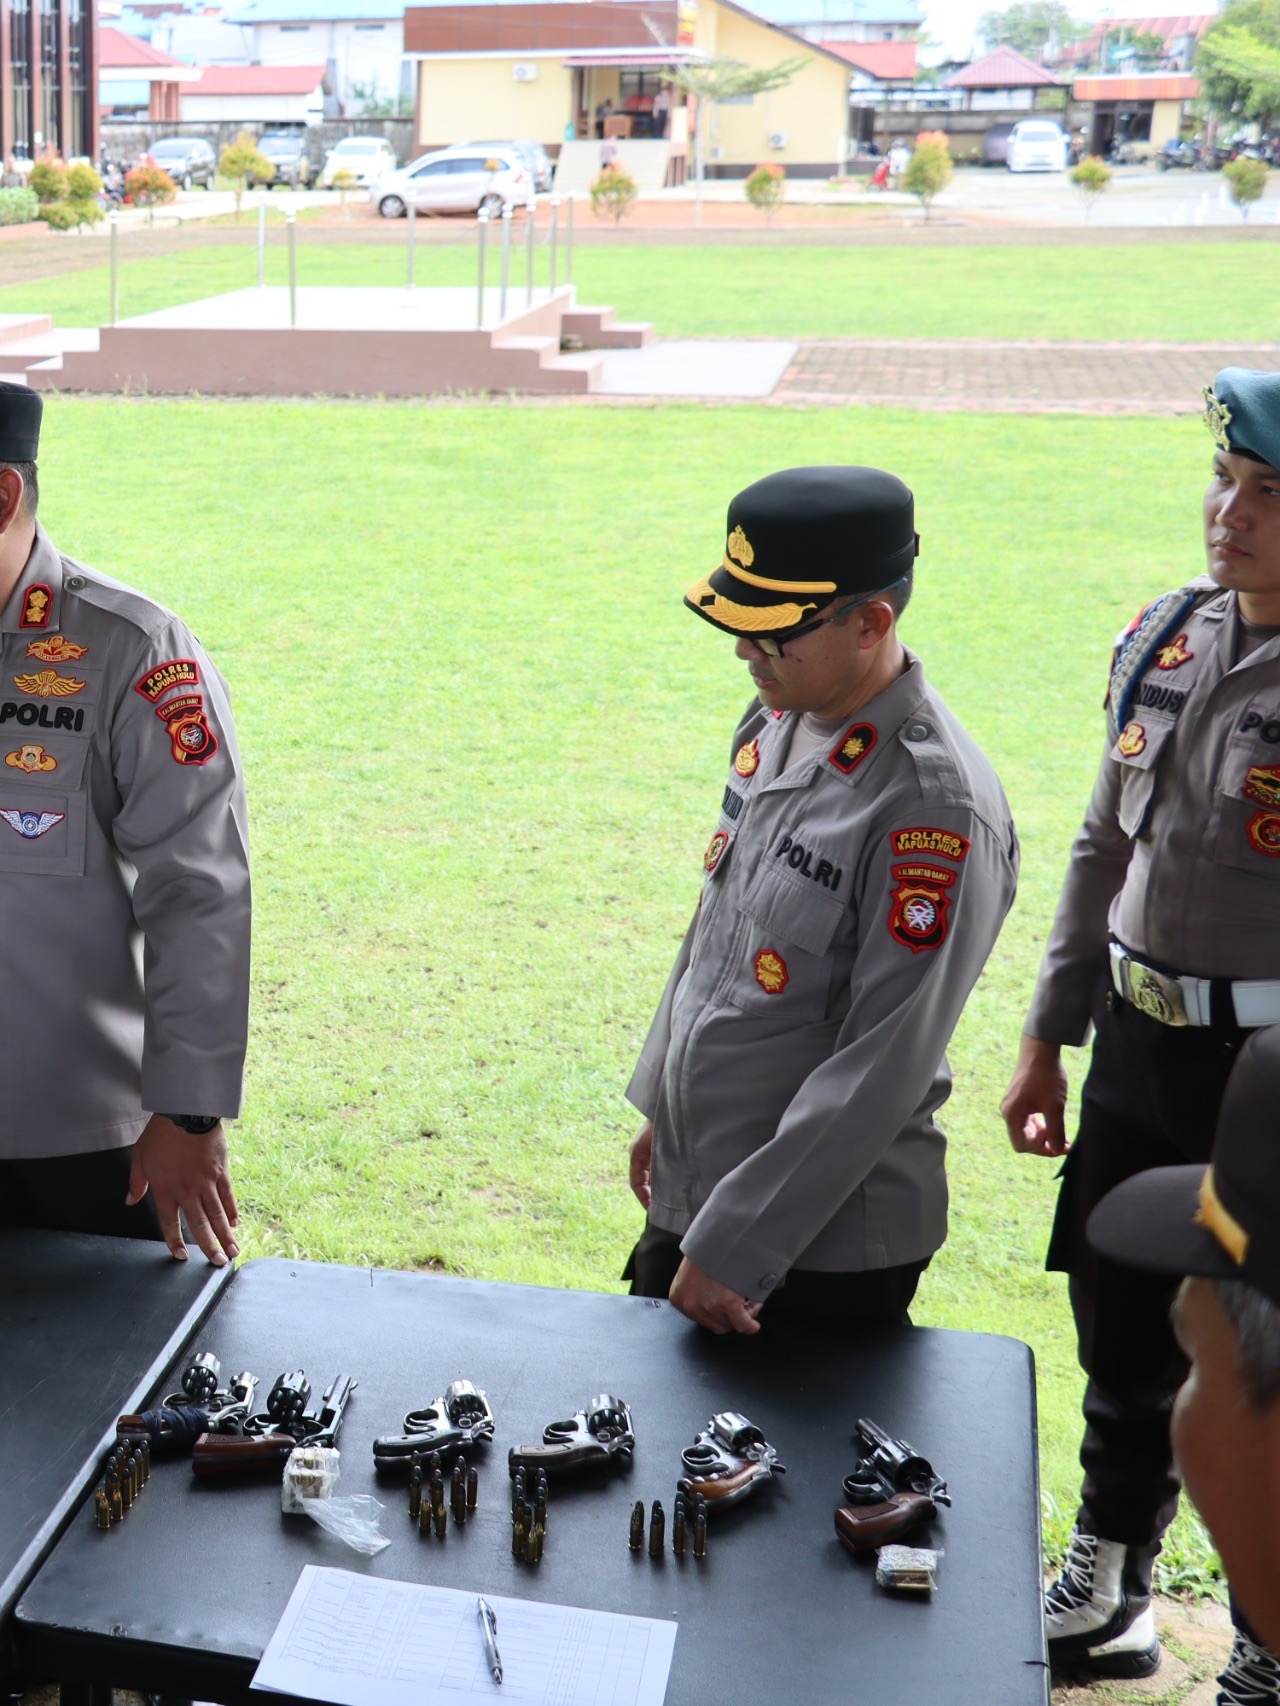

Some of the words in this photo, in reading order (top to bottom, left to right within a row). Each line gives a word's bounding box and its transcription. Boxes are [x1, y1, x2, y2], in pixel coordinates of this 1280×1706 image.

[146, 663, 189, 687] POLRES
[148, 674, 176, 697] KAPUAS
[176, 671, 195, 681] HULU
[0, 702, 84, 731] POLRI
[897, 839, 936, 851] KAPUAS
[936, 842, 962, 857] HULU
[900, 831, 961, 848] POLRES
[776, 836, 842, 891] POLRI
